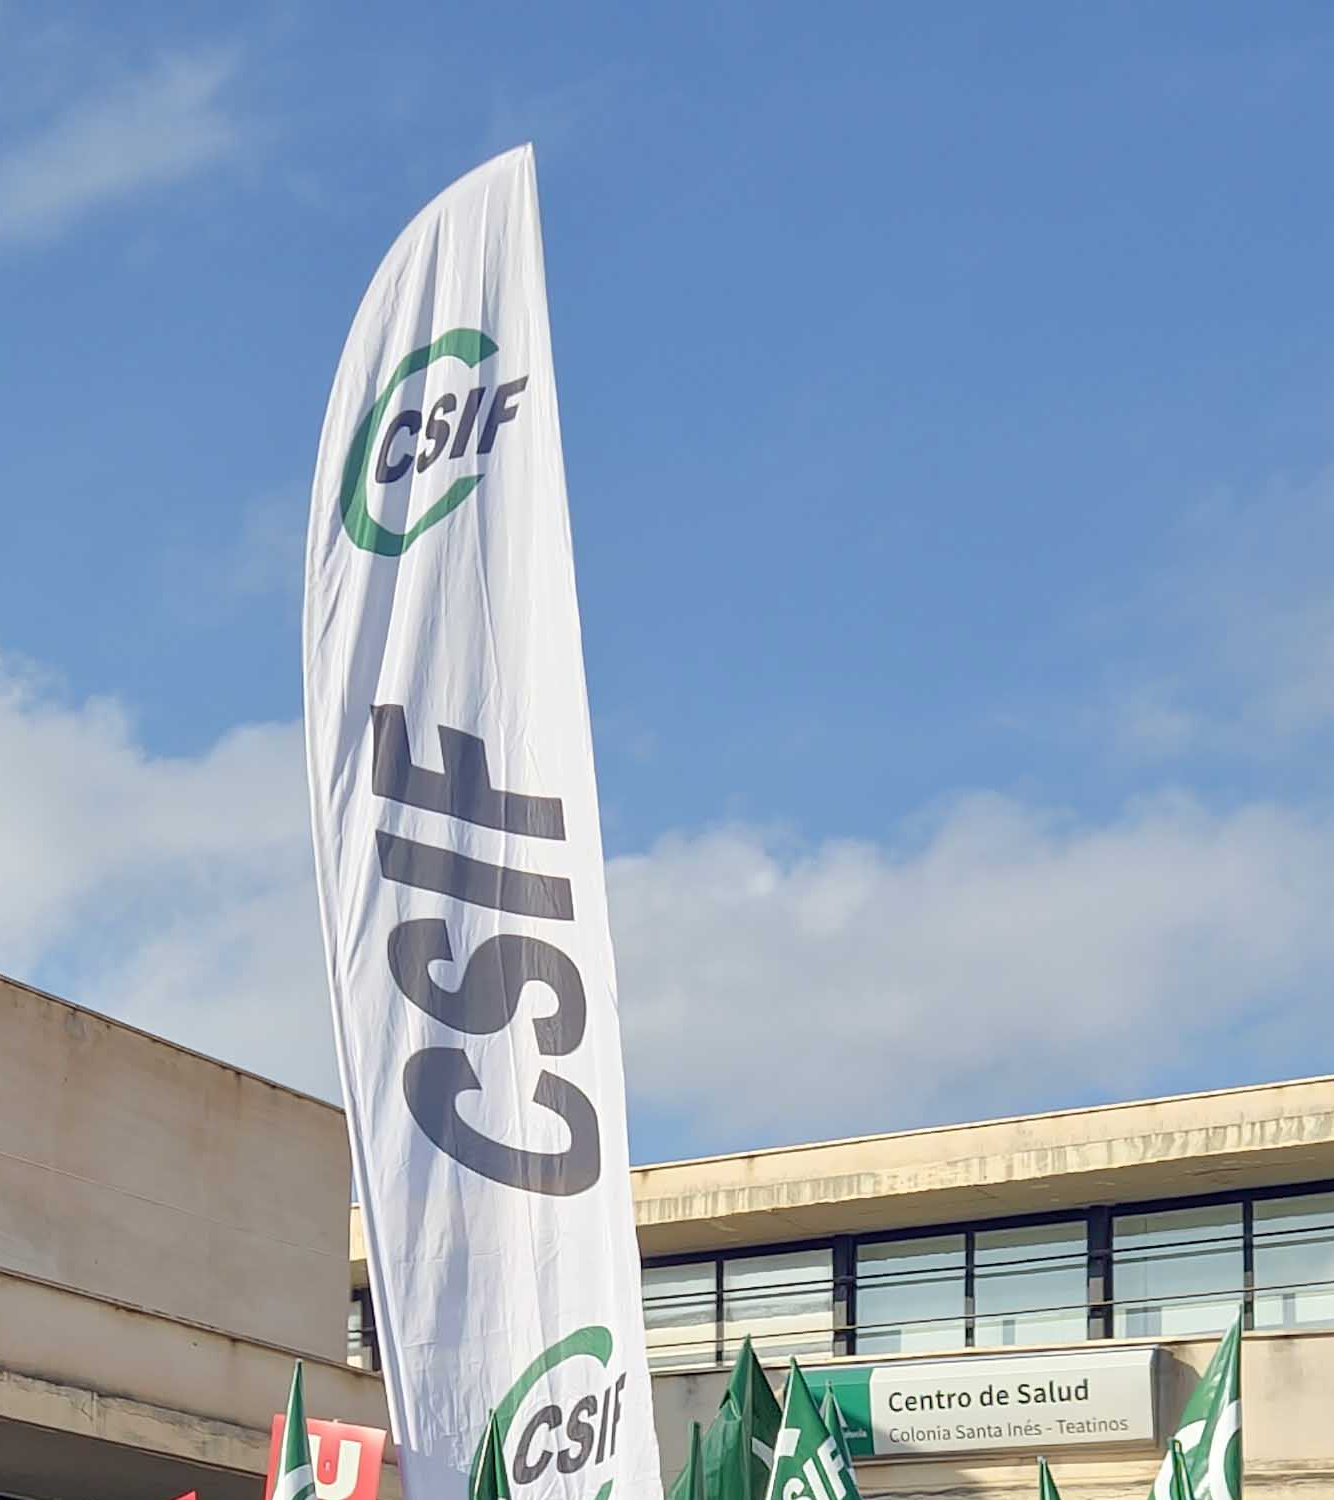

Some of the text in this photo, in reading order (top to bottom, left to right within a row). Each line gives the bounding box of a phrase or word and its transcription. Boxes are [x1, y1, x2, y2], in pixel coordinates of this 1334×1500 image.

[374, 375, 529, 484] CSIF
[370, 704, 601, 1197] CSIF
[888, 1378, 1089, 1413] Centro de Salud
[889, 1425, 951, 1444] Colonia
[956, 1422, 1003, 1441] Santa
[1007, 1418, 1043, 1437] Inés
[1055, 1416, 1129, 1435] Teatinos
